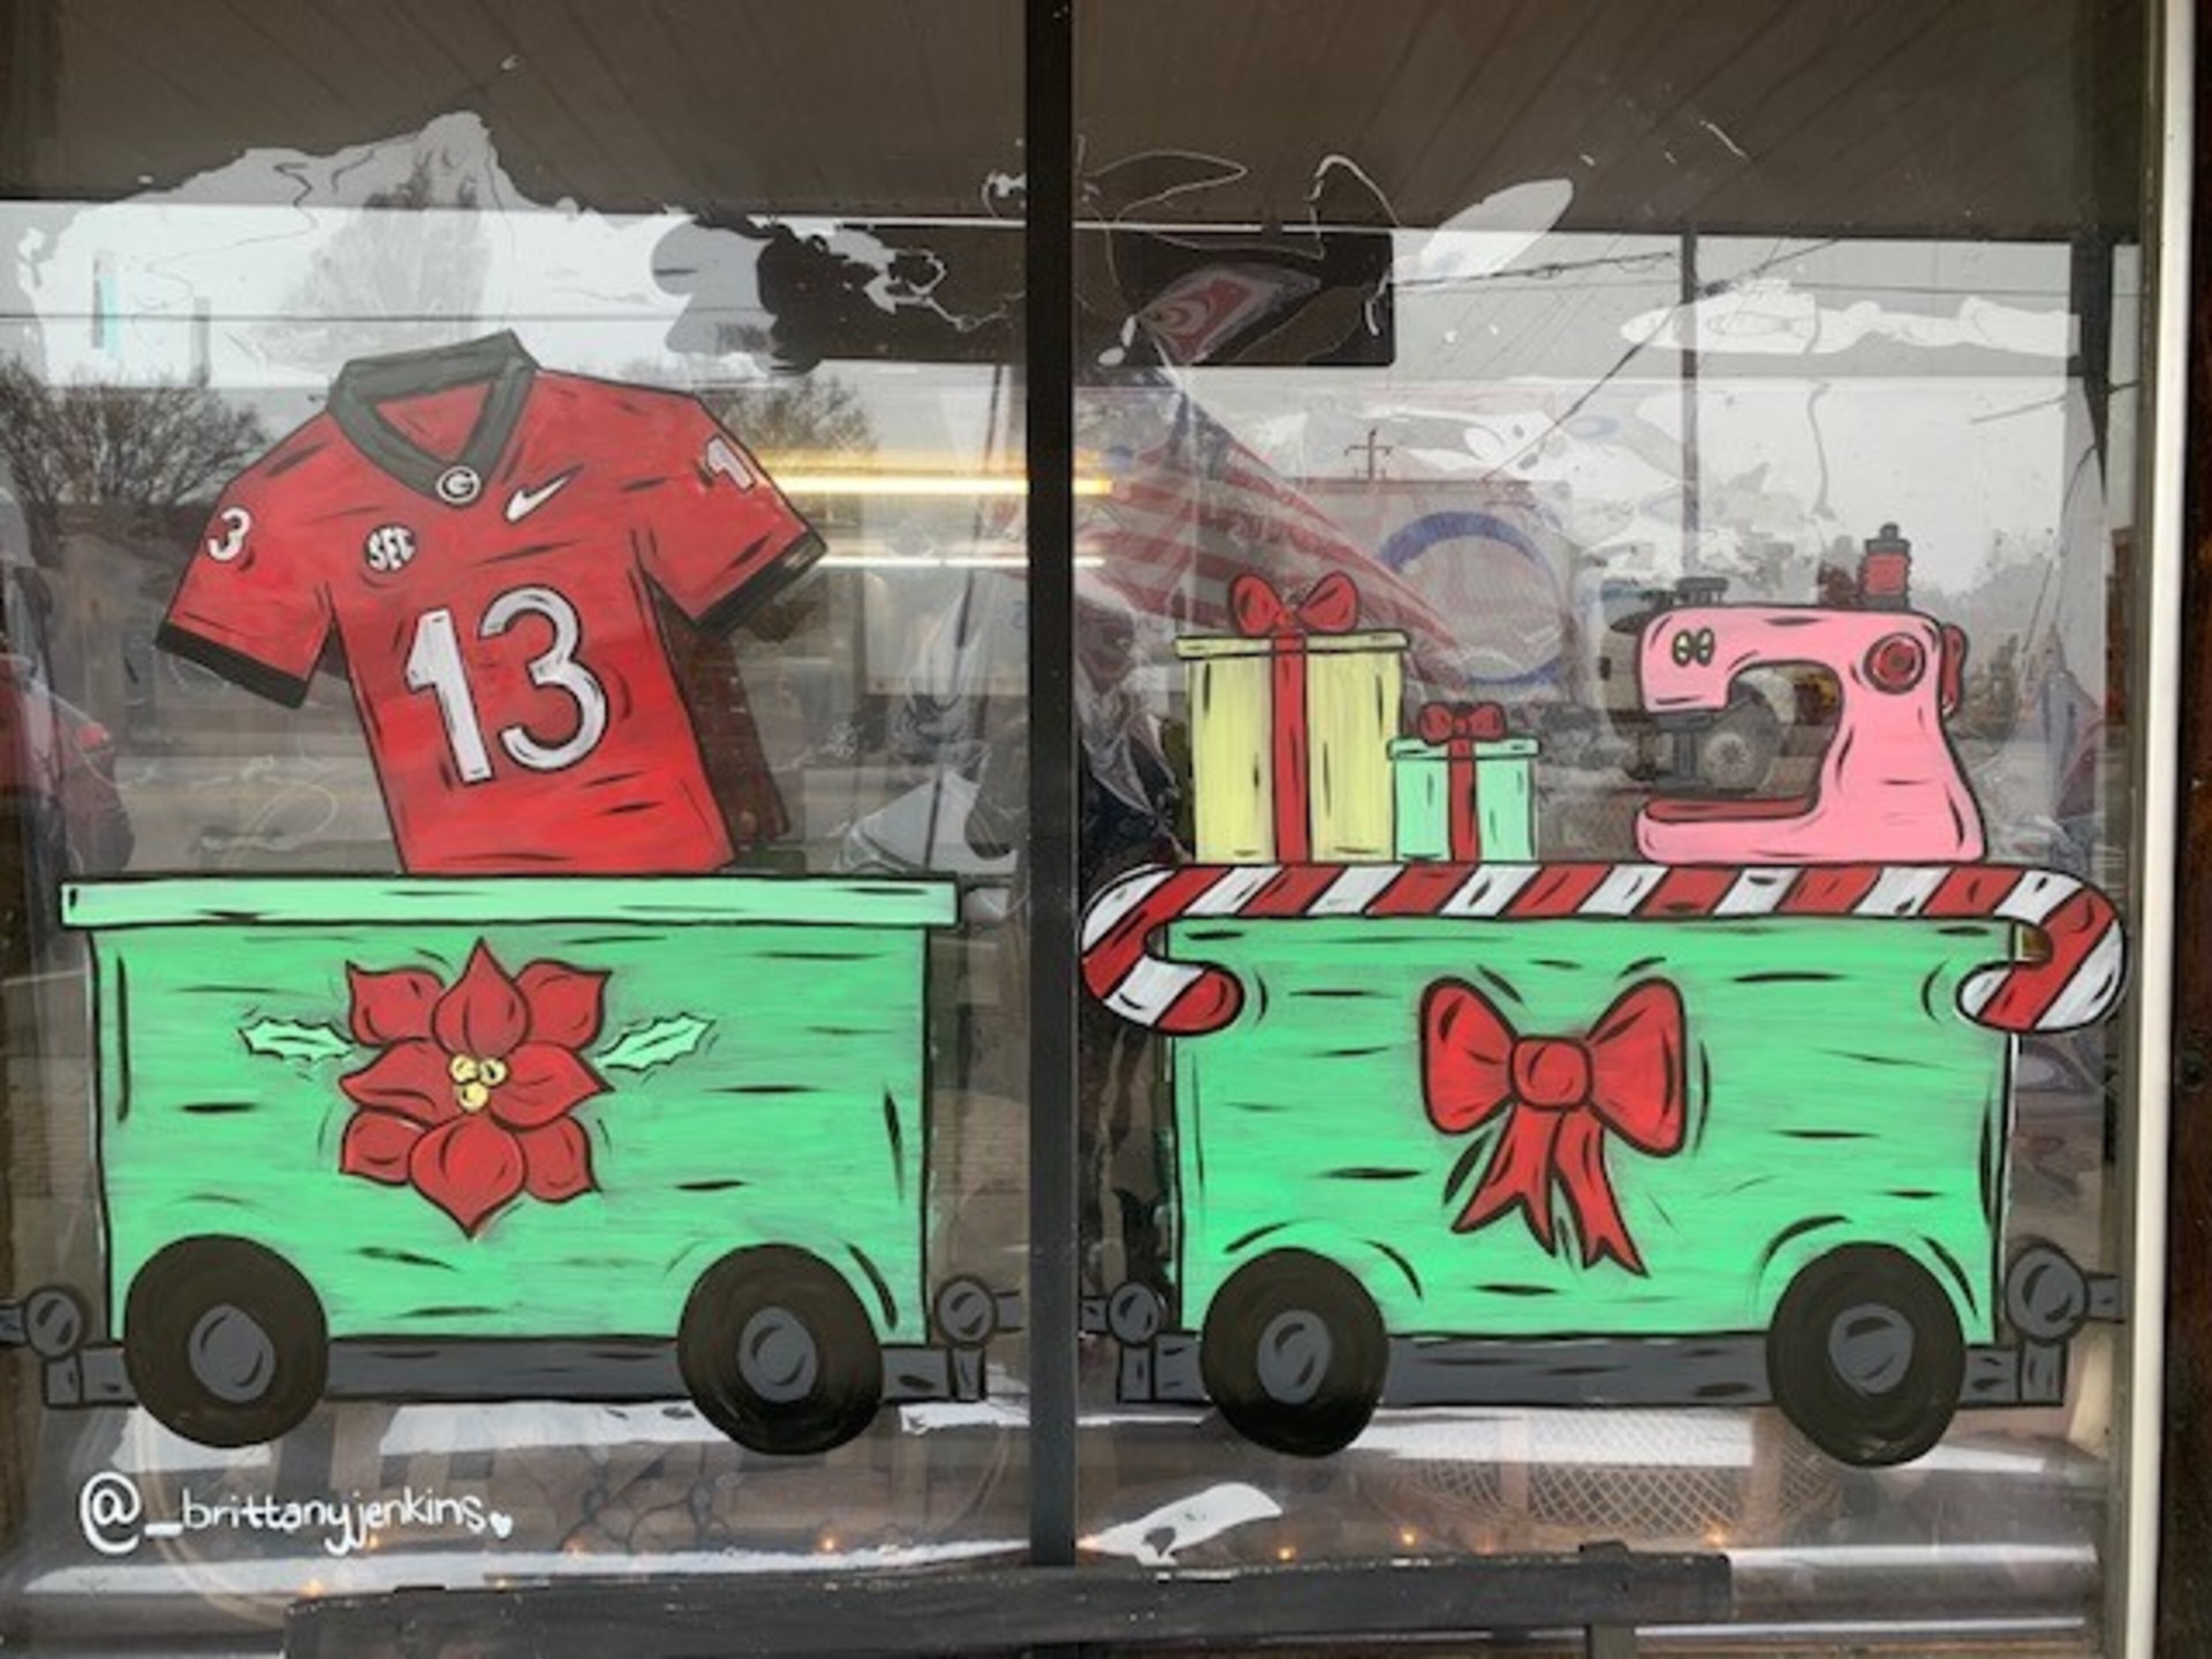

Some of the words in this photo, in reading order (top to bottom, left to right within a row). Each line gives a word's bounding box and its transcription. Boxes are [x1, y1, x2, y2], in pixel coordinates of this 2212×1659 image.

[437, 467, 480, 503] G
[707, 435, 756, 493] 1
[207, 508, 252, 562] 3
[367, 525, 416, 572] SEC
[405, 585, 608, 784] 13
